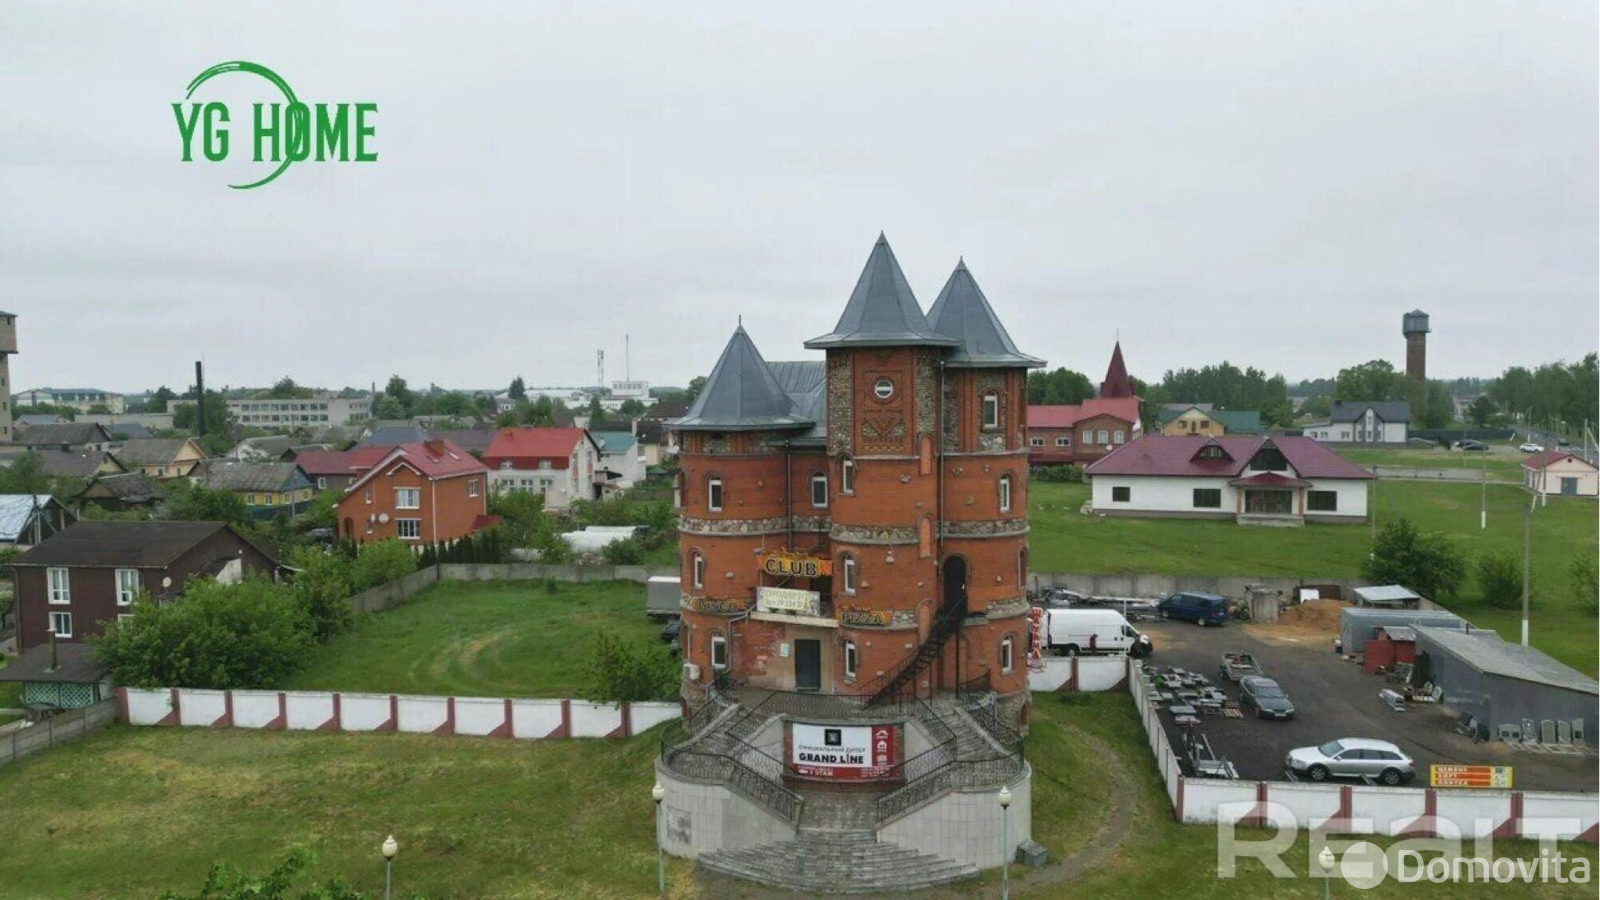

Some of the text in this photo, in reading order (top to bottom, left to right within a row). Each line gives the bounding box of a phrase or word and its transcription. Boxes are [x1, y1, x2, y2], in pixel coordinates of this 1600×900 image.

[765, 558, 817, 576] CLUB
[842, 612, 883, 624] PIZZA
[799, 752, 864, 764] GRAND LINE
